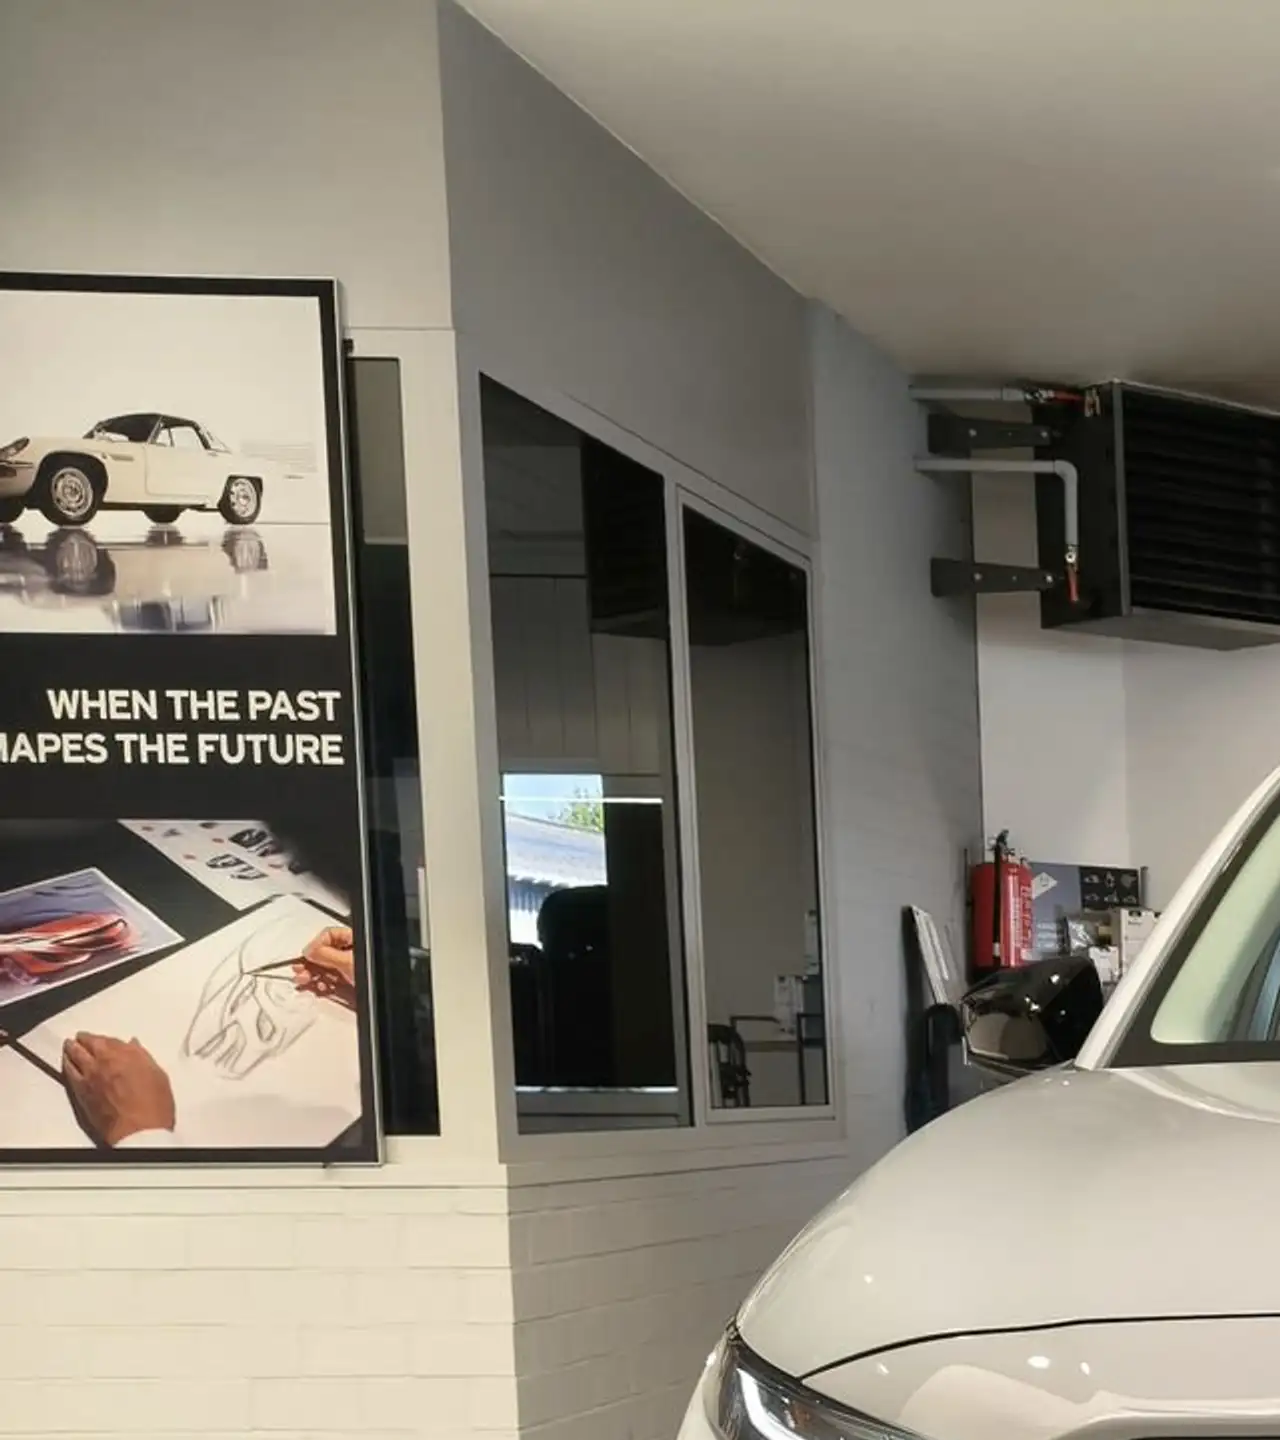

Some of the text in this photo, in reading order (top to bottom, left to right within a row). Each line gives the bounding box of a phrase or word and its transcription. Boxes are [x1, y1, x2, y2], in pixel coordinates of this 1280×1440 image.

[47, 689, 341, 721] WHEN THE PAST
[115, 733, 190, 764] THE
[198, 733, 345, 765] FUTURE
